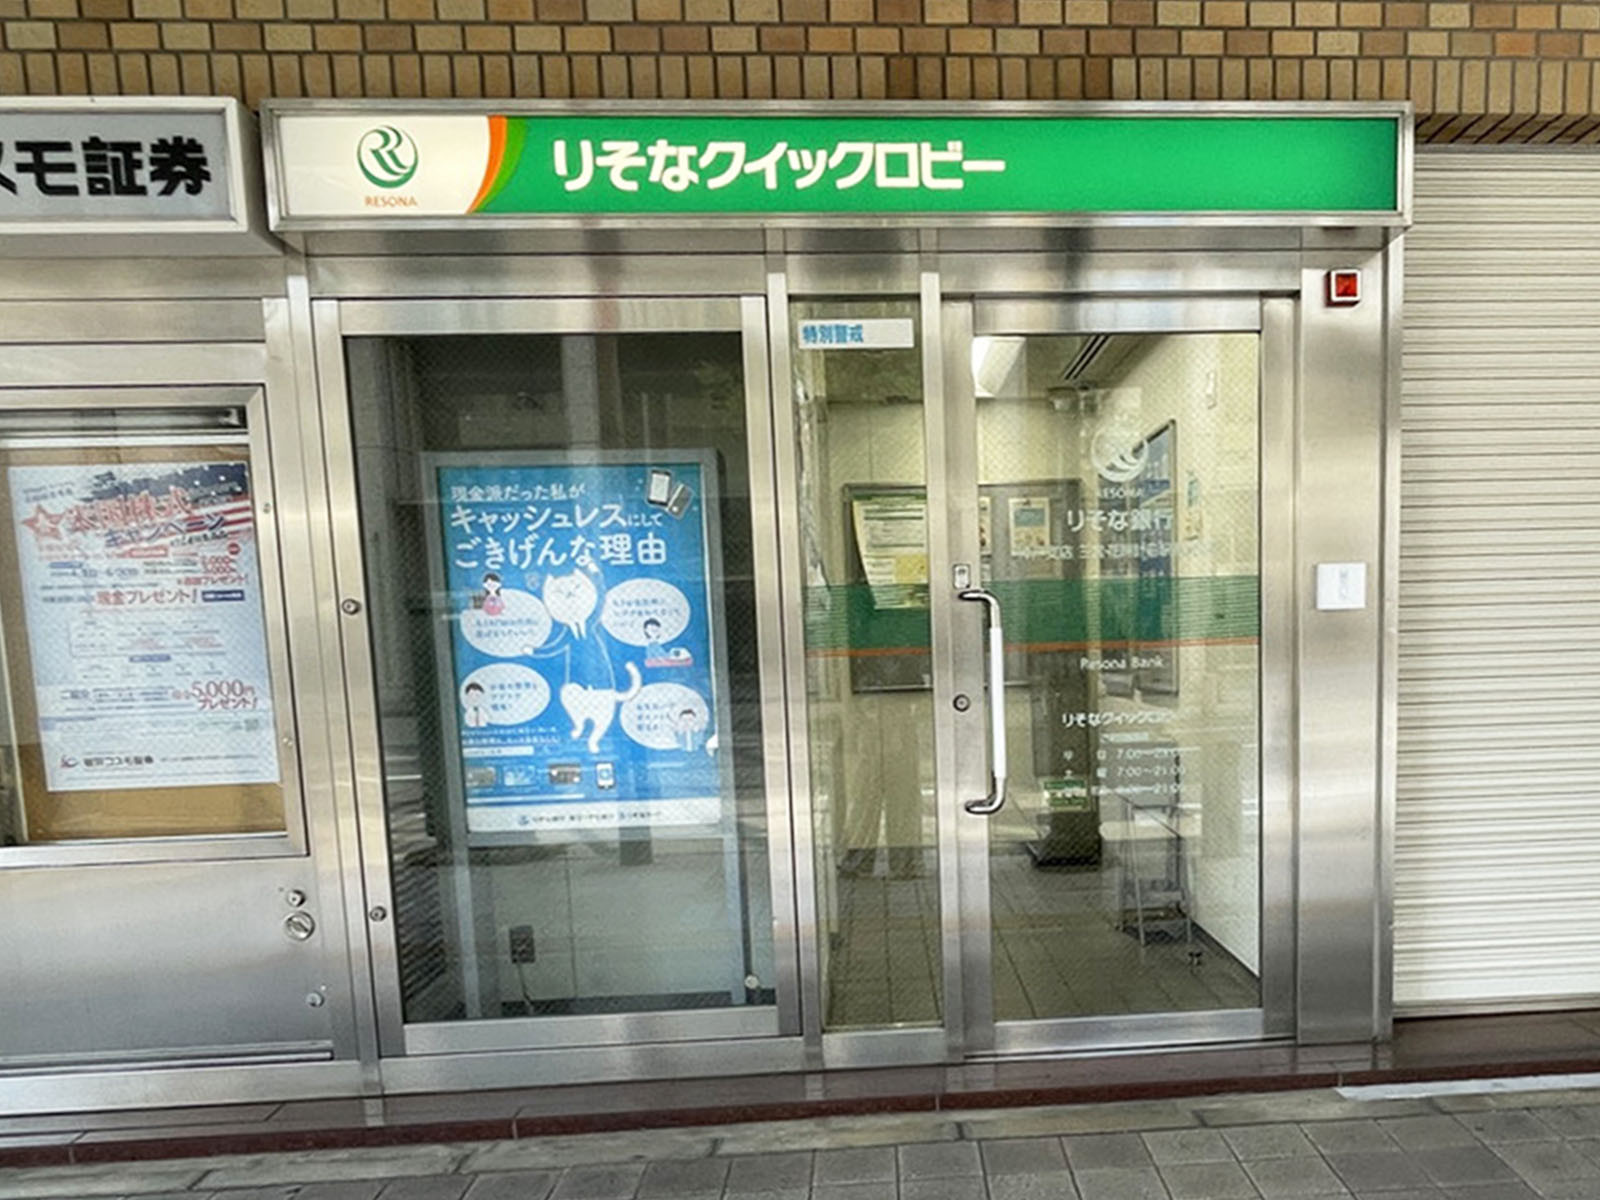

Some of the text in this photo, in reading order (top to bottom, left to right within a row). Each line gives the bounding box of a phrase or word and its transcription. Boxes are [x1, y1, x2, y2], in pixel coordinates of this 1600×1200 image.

[553, 138, 1006, 193] りそなクイックロビー
[364, 196, 418, 208] RESONA
[802, 323, 863, 343] 特別警戒
[451, 483, 586, 502] 現金派だった私が
[450, 504, 663, 533] キャッシュレスにして
[1066, 507, 1174, 533] りそな銀行
[455, 532, 667, 570] ごきげんな理由
